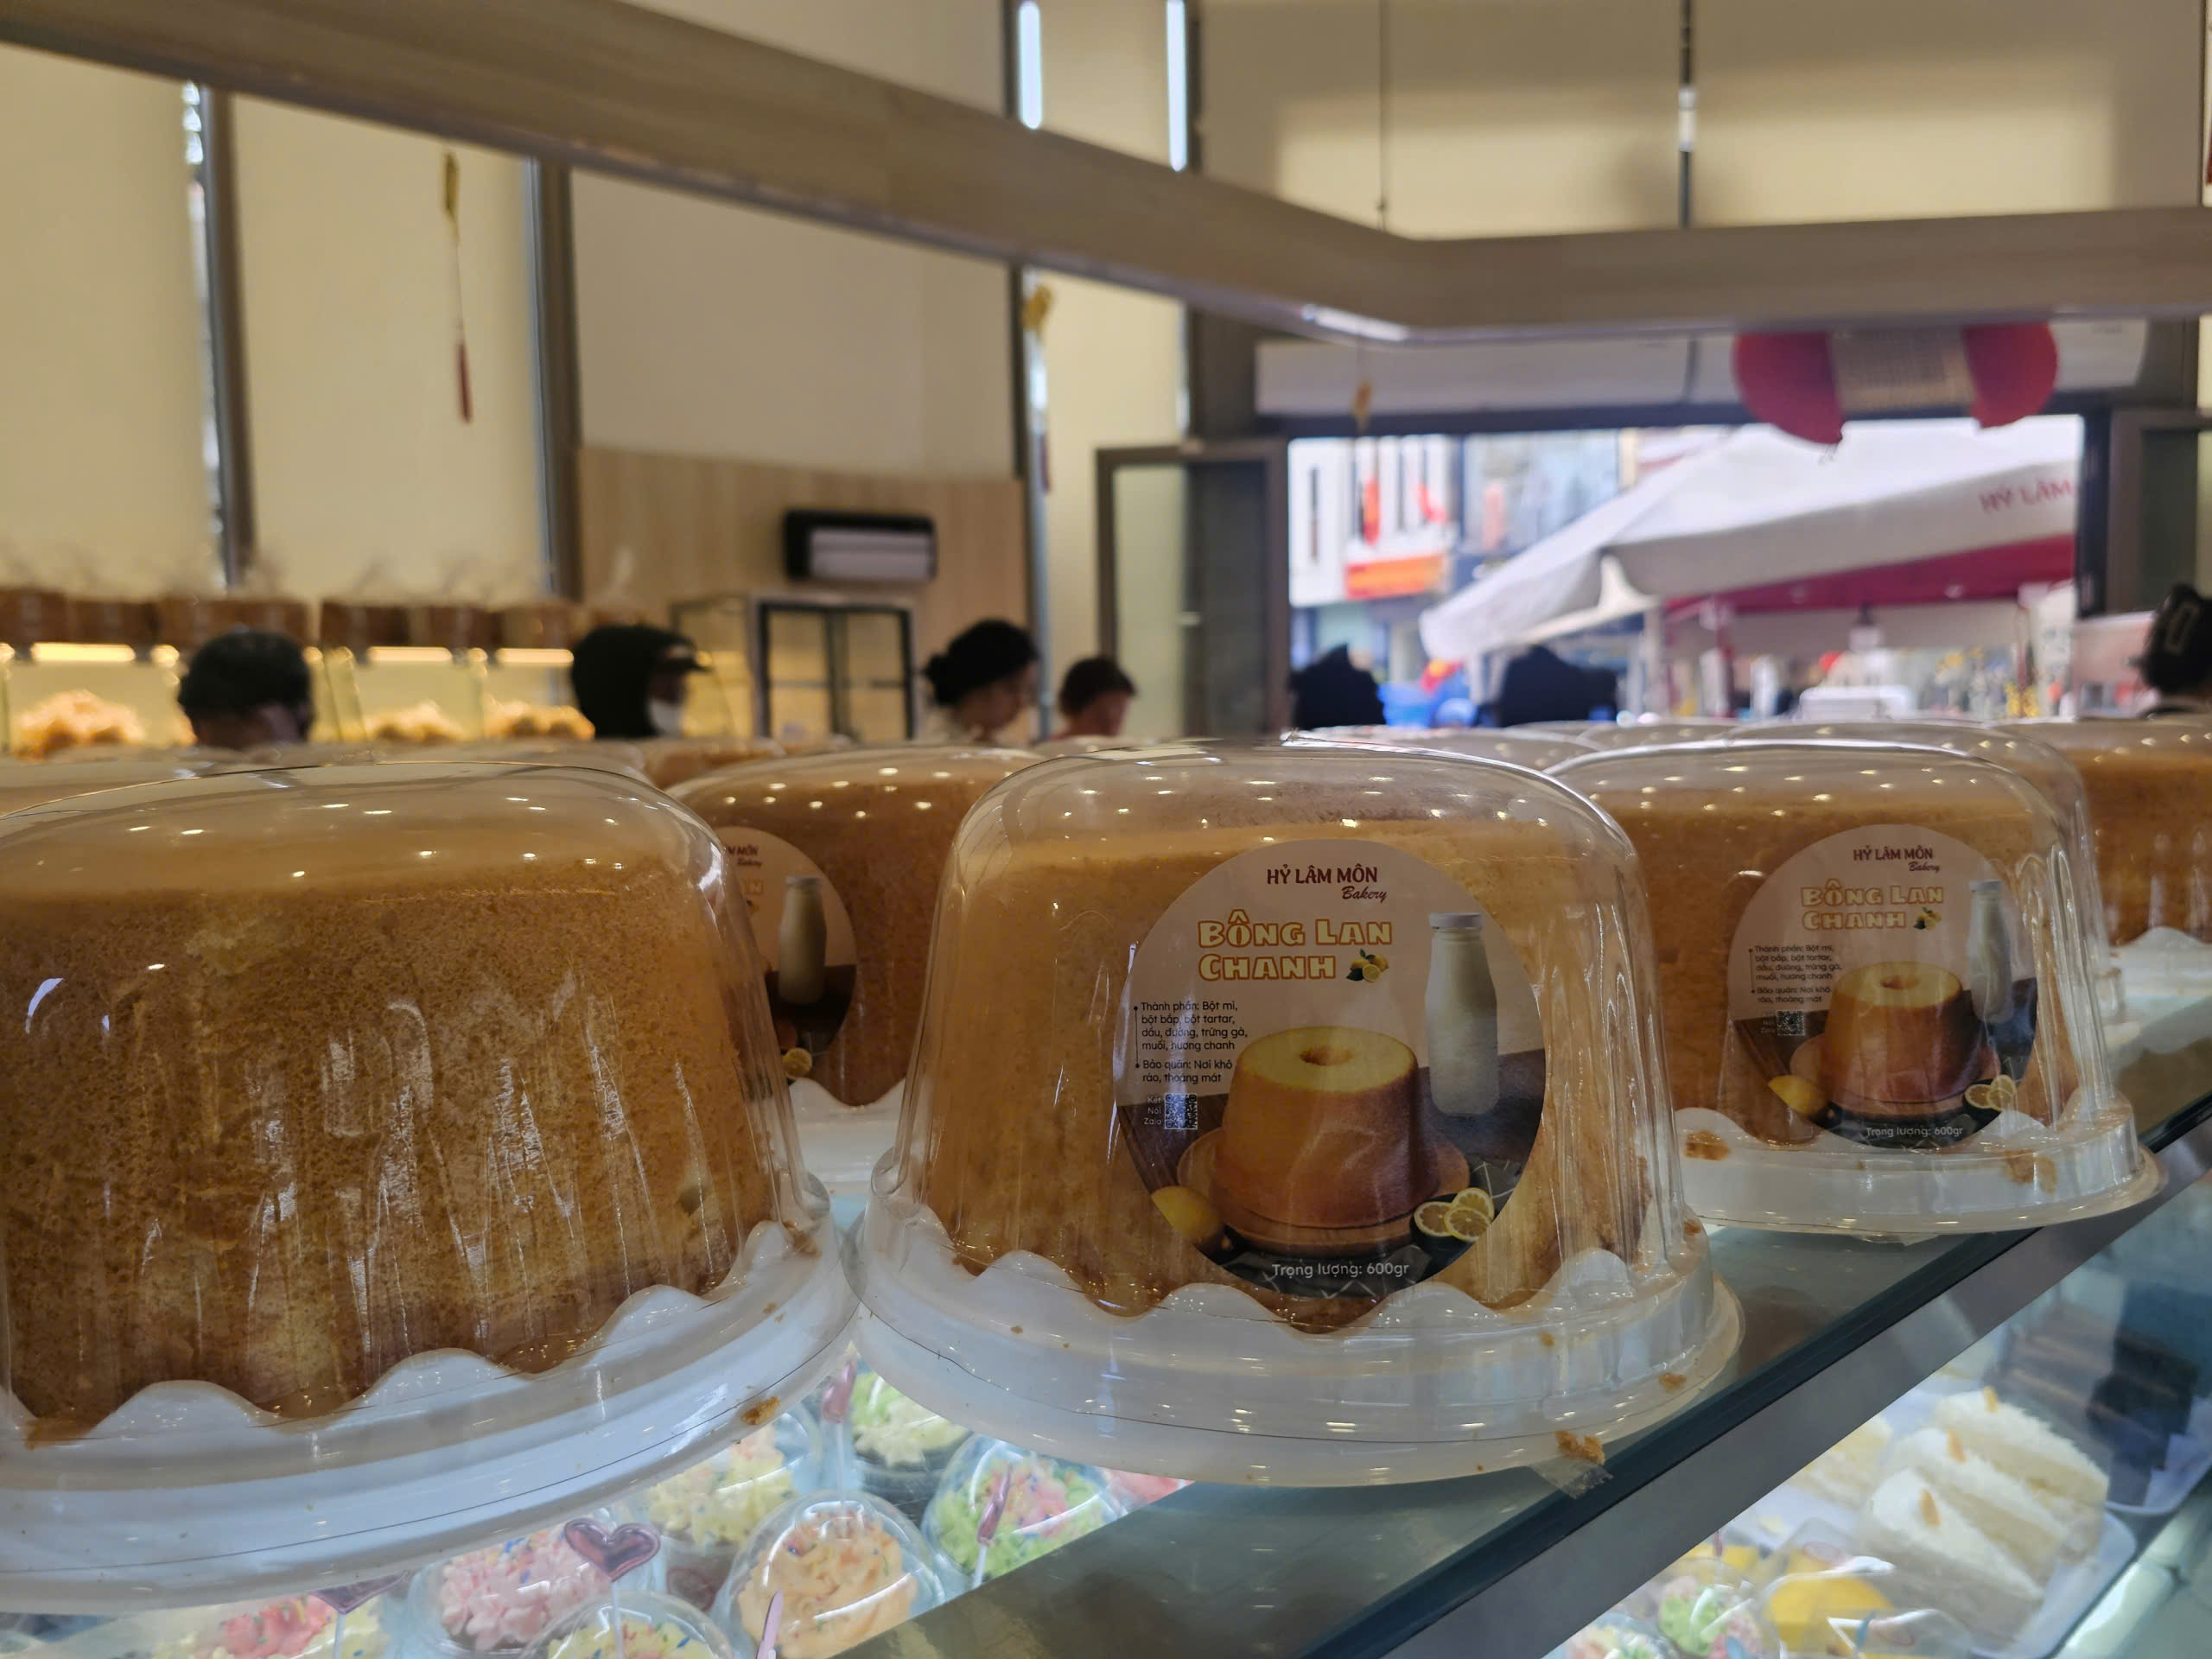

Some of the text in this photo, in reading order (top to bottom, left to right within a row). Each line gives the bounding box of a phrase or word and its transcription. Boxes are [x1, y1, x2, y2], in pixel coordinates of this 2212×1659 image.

[1853, 845, 1933, 861] HỶ LÂM MÔN
[1267, 863, 1378, 884] HỶ LÂM MÔN
[1908, 861, 1940, 874] Bakery
[1341, 886, 1388, 903] Bakery
[1801, 878, 1943, 906] BÔNG LAN
[1802, 911, 1906, 931] CHANH
[1198, 909, 1393, 948] BÔNG LAN
[1198, 954, 1336, 982] CHANH
[1141, 1001, 1170, 1012] Thành
[1202, 1001, 1219, 1012] Bột
[1141, 1014, 1157, 1026] bột
[1204, 1014, 1235, 1025] tartar,
[1201, 1027, 1228, 1039] trứng
[1230, 1027, 1248, 1039] gà,
[1204, 1040, 1235, 1050] chanh
[1142, 1058, 1161, 1069] Bảo
[1193, 1059, 1211, 1069] Nơi
[1214, 1059, 1232, 1069] khô
[1164, 1072, 1198, 1084] thoáng
[1201, 1072, 1221, 1082] mát
[1934, 1126, 1963, 1137] 600gr
[1271, 1262, 1409, 1279] Trọng lượng: 600gr
